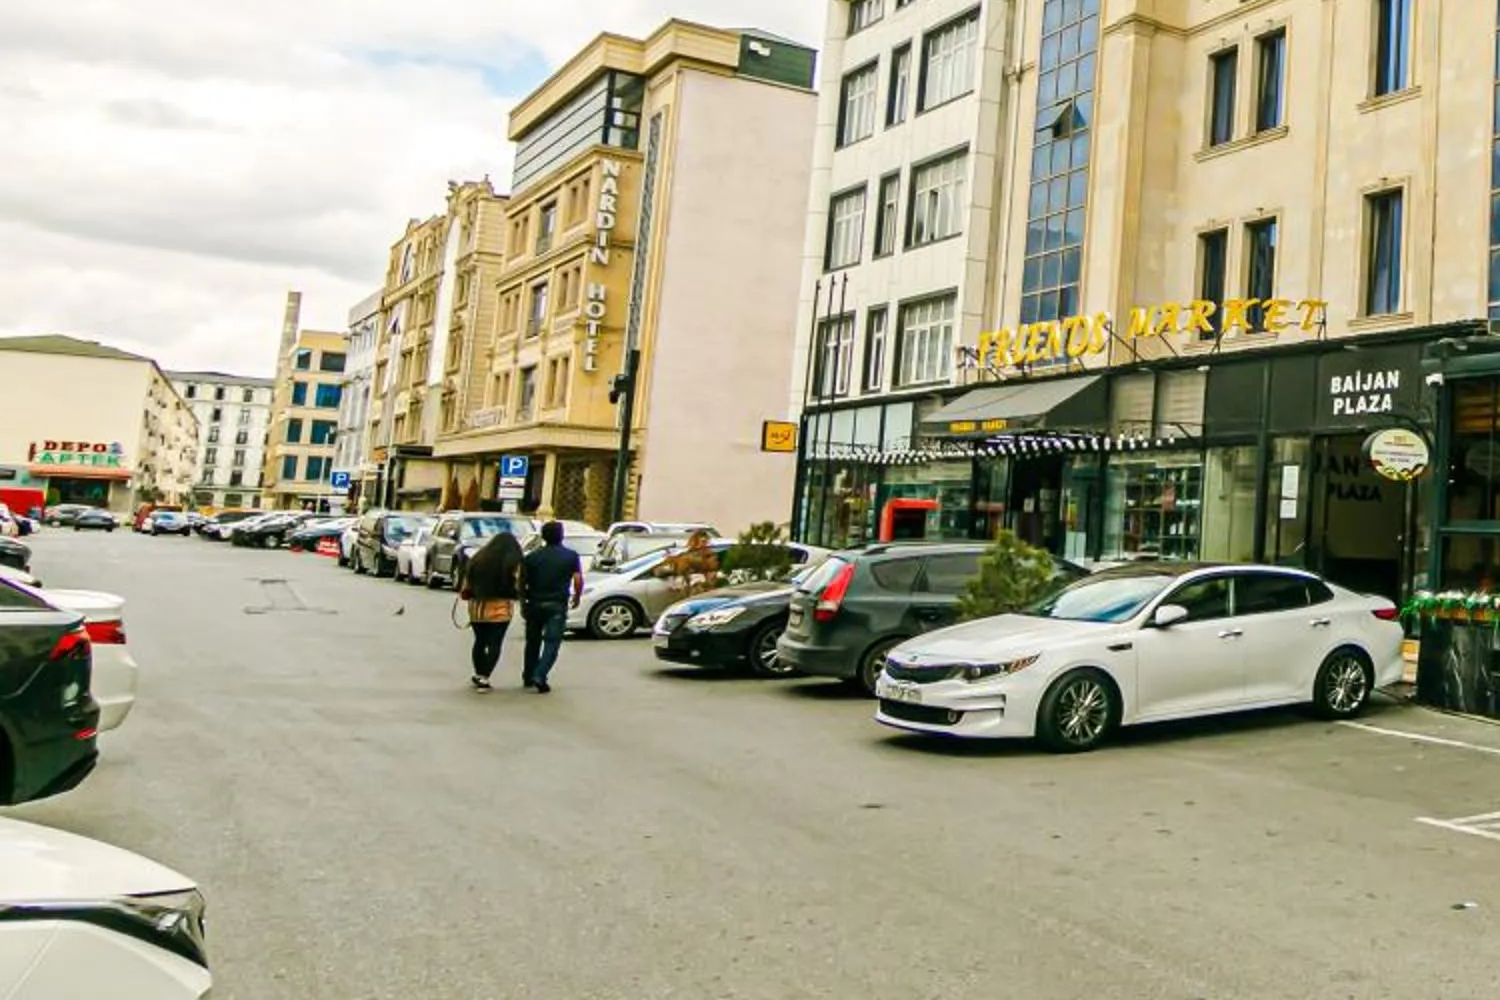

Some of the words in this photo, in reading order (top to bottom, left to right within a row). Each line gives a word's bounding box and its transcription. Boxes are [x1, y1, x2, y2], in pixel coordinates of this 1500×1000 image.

[591, 159, 621, 266] NARDIN
[584, 282, 607, 373] HOTEL
[976, 311, 1109, 368] FRIENDS
[1126, 297, 1328, 341] MARKET
[1330, 369, 1401, 395] BAİJAN
[1332, 393, 1394, 416] PLAZA
[43, 439, 107, 453] DEPO
[40, 452, 121, 467] APTEK
[509, 457, 523, 473] P
[335, 472, 347, 485] P
